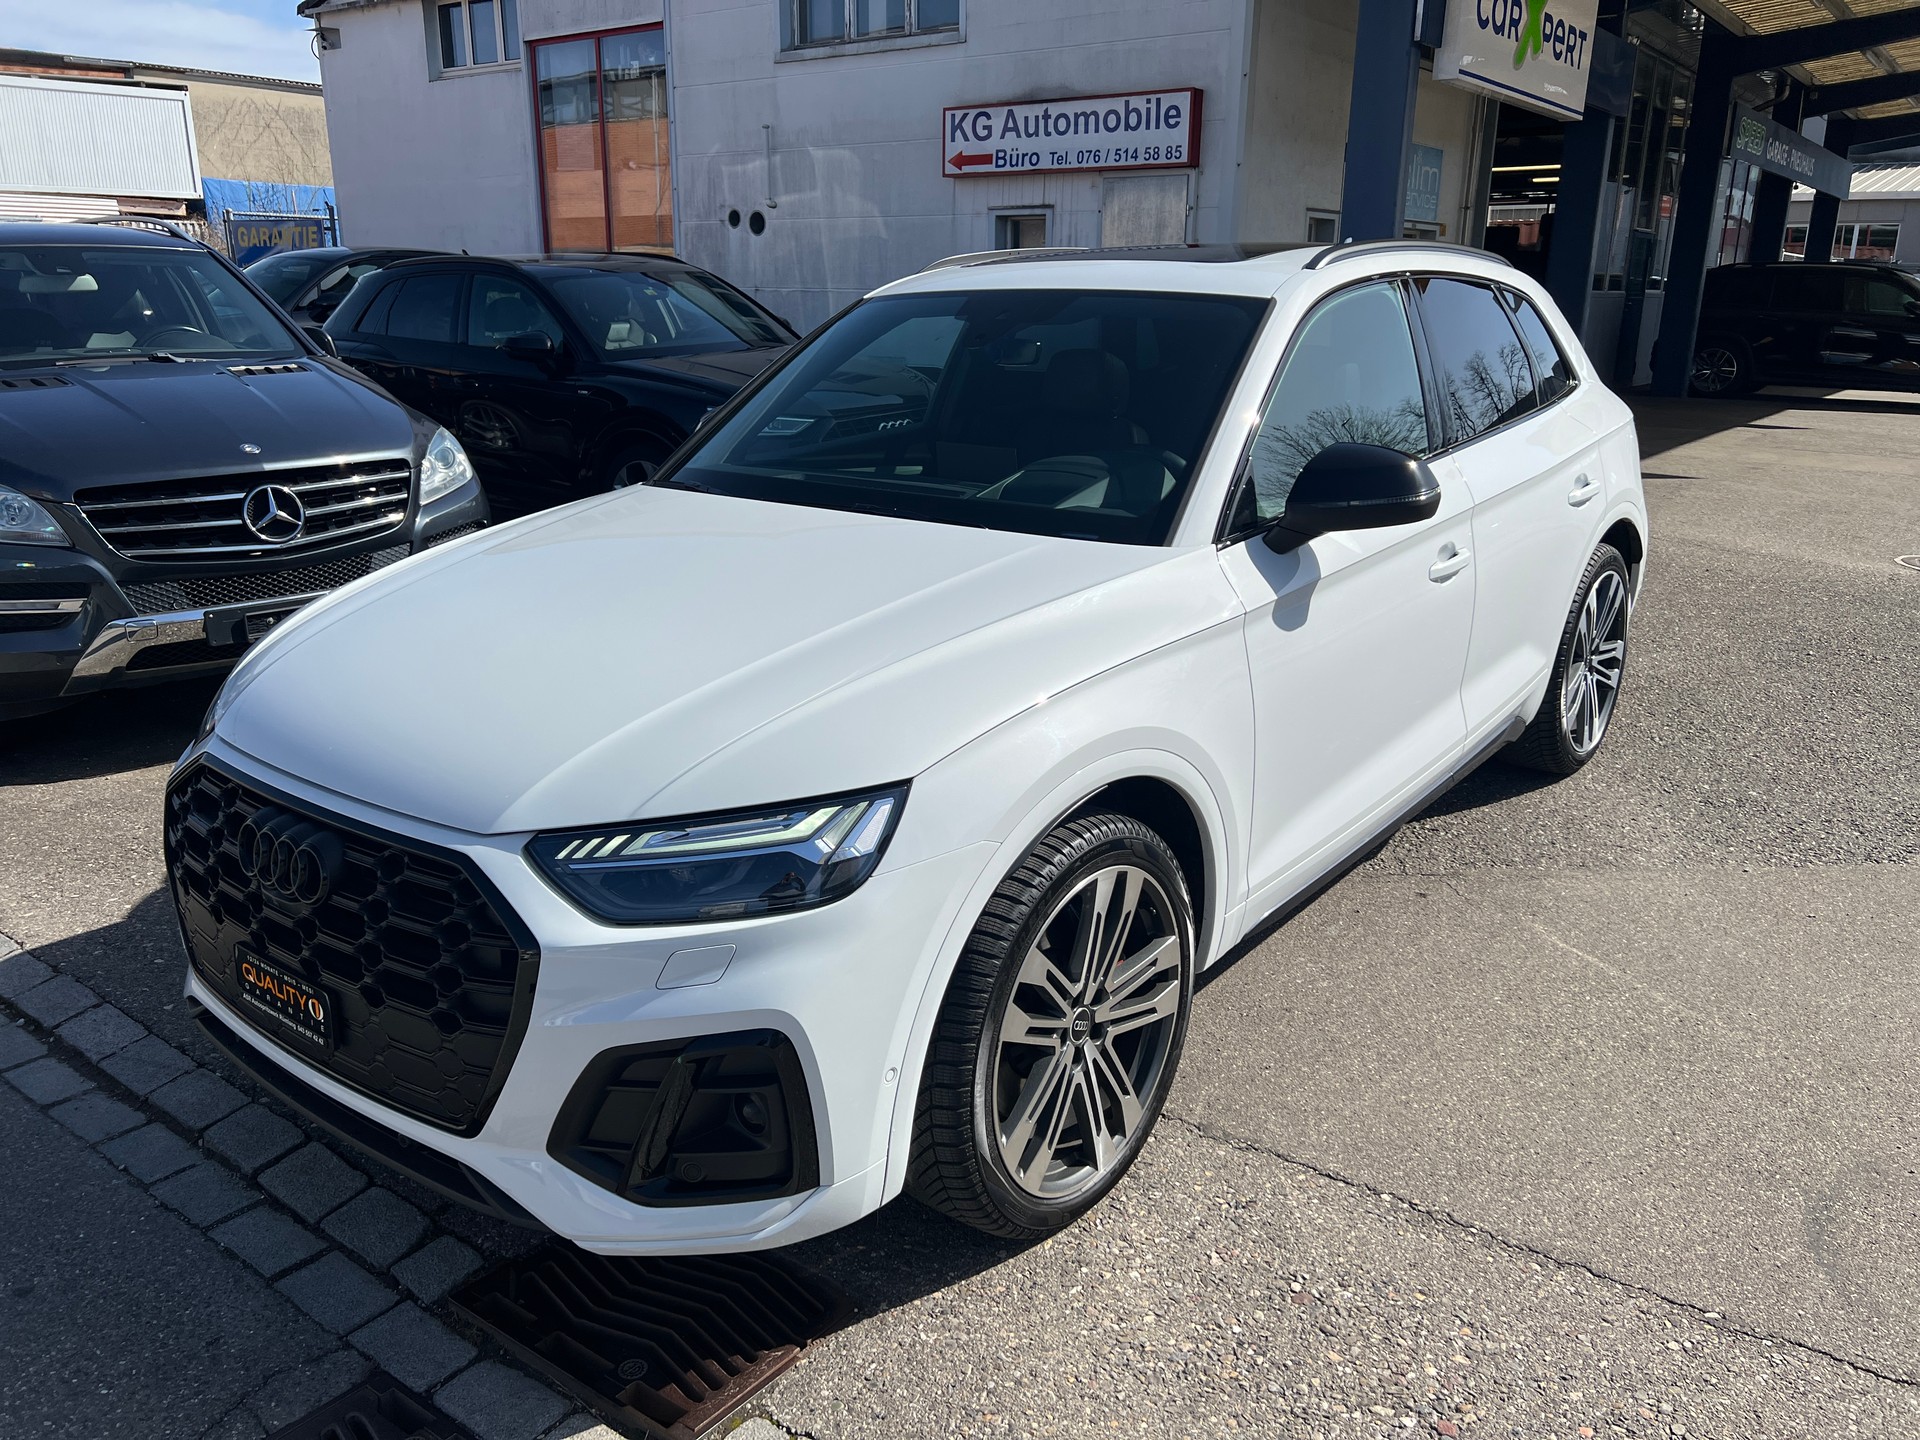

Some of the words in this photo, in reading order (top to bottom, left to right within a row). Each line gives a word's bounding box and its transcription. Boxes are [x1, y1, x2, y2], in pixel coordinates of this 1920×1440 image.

[950, 110, 993, 143] KG
[999, 97, 1182, 140] Automobile
[1736, 116, 1767, 156] SPEED
[995, 148, 1041, 169] Büro
[1049, 151, 1072, 166] Tel.
[1076, 149, 1101, 165] 076
[1104, 148, 1111, 163] /
[1113, 146, 1139, 163] 514
[1143, 145, 1160, 161] 58
[1165, 144, 1183, 160] 85
[1766, 137, 1789, 166] GARAGE
[237, 226, 318, 248] GARANTIE
